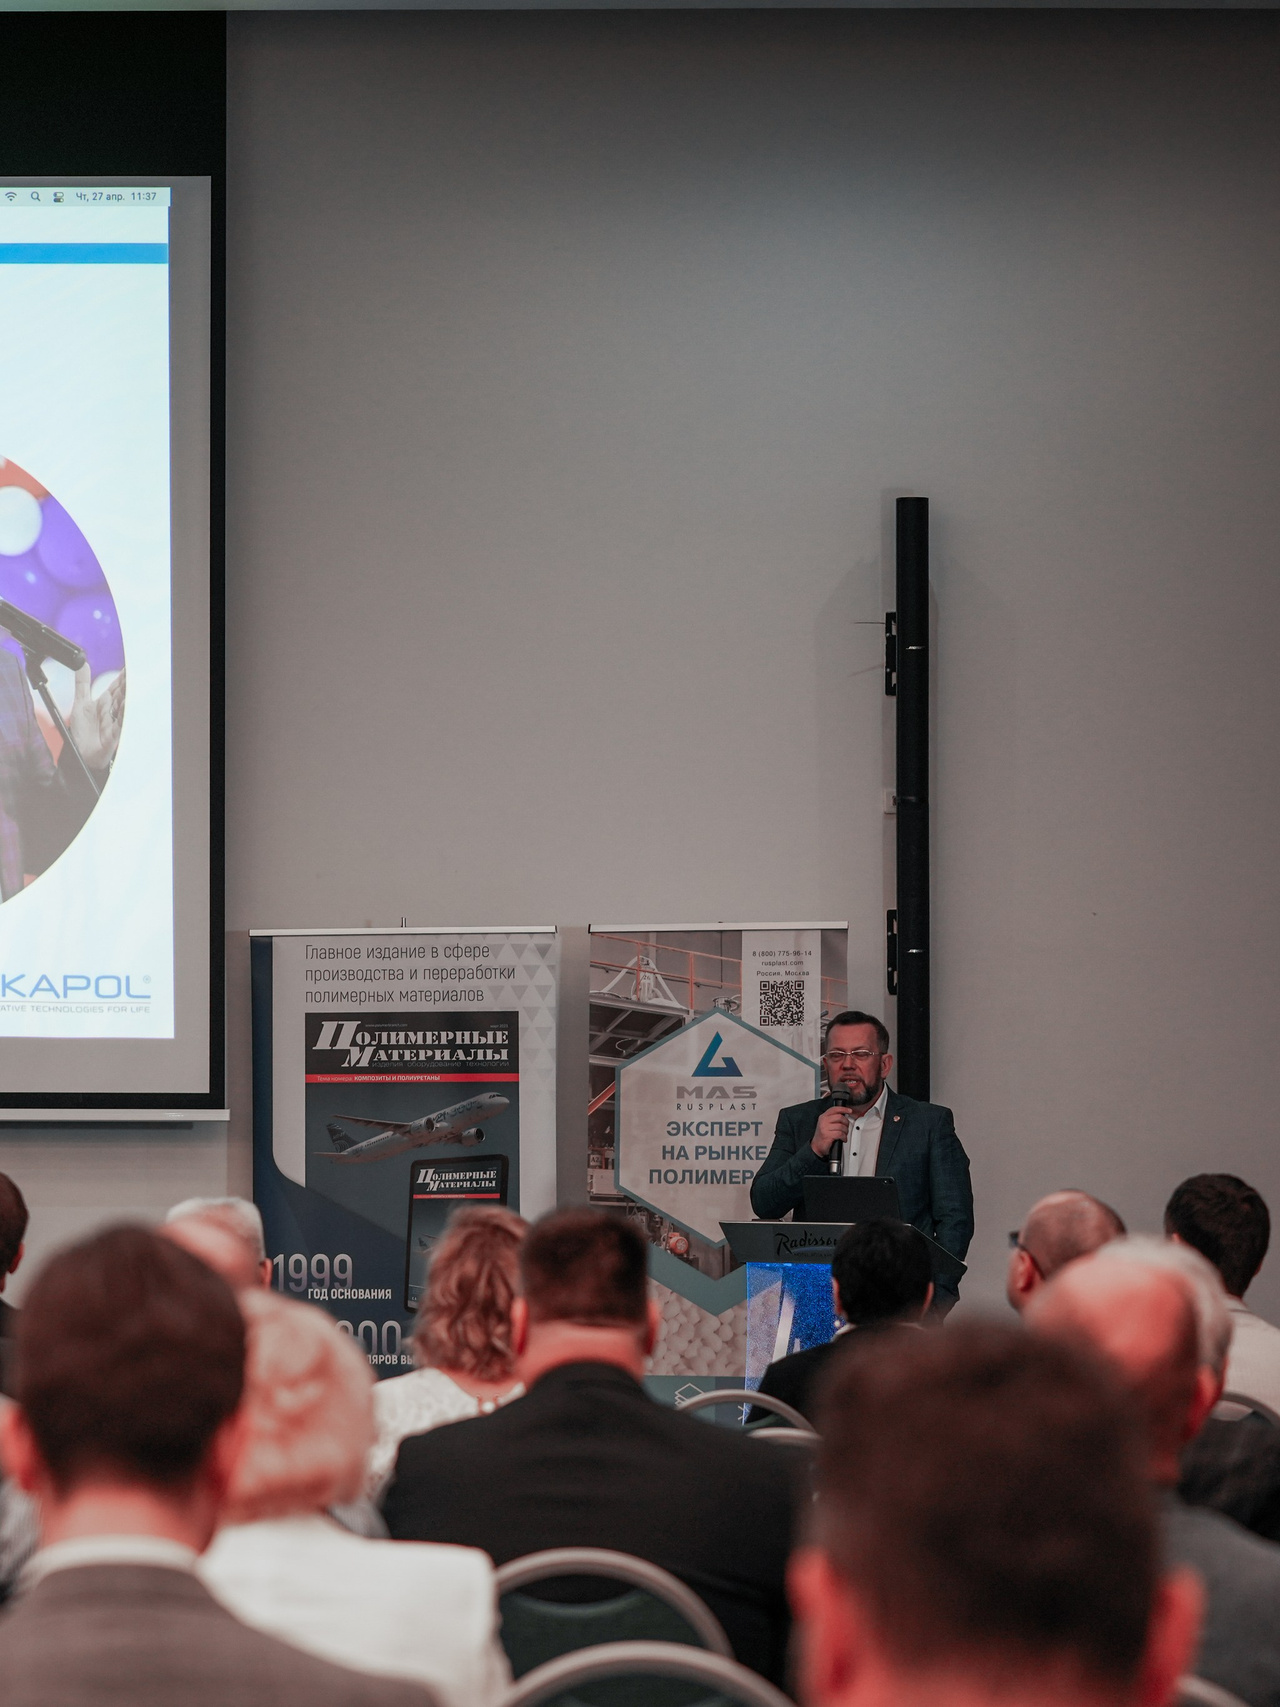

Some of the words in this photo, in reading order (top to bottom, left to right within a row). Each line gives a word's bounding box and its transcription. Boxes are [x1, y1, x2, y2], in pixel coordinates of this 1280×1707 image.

[75, 192, 90, 203] Чт,
[92, 191, 104, 201] 27
[105, 193, 125, 203] апр.
[131, 191, 156, 201] 11:37
[305, 944, 362, 960] Главное
[366, 946, 426, 961] издание
[431, 946, 439, 959] в
[443, 942, 490, 962] сфере
[758, 950, 776, 958] (800)
[305, 968, 404, 985] производства
[409, 968, 418, 980] и
[423, 963, 516, 984] переработки
[305, 990, 395, 1006] полимерных
[399, 989, 485, 1006] материалов
[30, 1005, 105, 1014] TECHNOLOGIES
[107, 1005, 128, 1014] FOR
[130, 1005, 150, 1014] LIFE
[676, 1085, 757, 1099] MAS
[676, 1103, 757, 1111] RUSPLAST
[666, 1120, 764, 1137] ЭКСПЕРТ
[661, 1144, 690, 1161] НА
[694, 1145, 767, 1161] РЫНКЕ
[649, 1169, 755, 1185] ПОЛИМЕР
[273, 1253, 353, 1293] 1999
[308, 1288, 329, 1301] ГОД
[330, 1288, 392, 1300] ОСНОВАНИЯ
